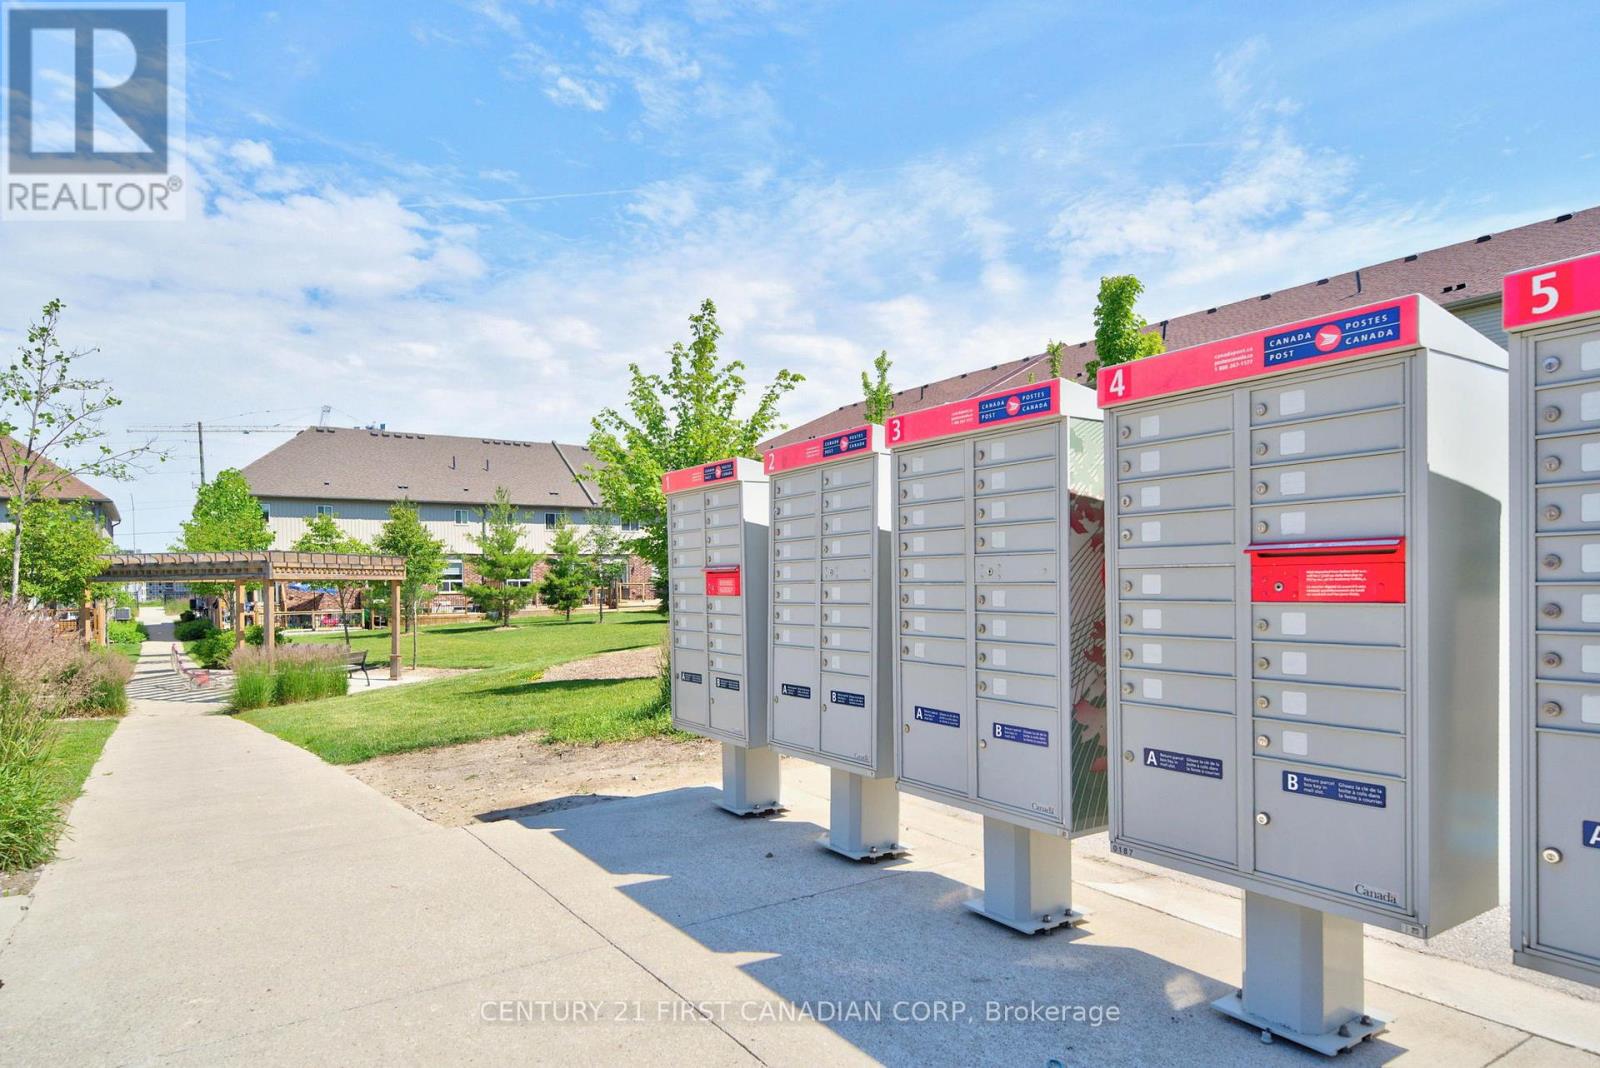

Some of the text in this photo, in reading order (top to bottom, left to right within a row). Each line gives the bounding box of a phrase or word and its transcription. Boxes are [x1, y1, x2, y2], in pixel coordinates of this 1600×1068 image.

[1531, 271, 1559, 315] 5
[1345, 314, 1388, 330] POSTES
[1269, 332, 1312, 347] CANADA
[1345, 329, 1394, 345] CANADA
[1269, 350, 1294, 361] POST
[1109, 368, 1125, 397] 4
[1022, 391, 1045, 401] POSTES
[981, 400, 1005, 410] CANADA
[1022, 401, 1048, 412] CANADA
[981, 412, 996, 421] POST
[891, 419, 901, 441] 3
[768, 452, 775, 470] 2
[665, 475, 670, 490] 1
[782, 684, 788, 694] A
[831, 692, 837, 702] B
[916, 708, 923, 720] A
[995, 724, 1002, 737] B
[1146, 750, 1158, 766] A
[1287, 774, 1298, 790] B
[1355, 884, 1397, 904] Canada
